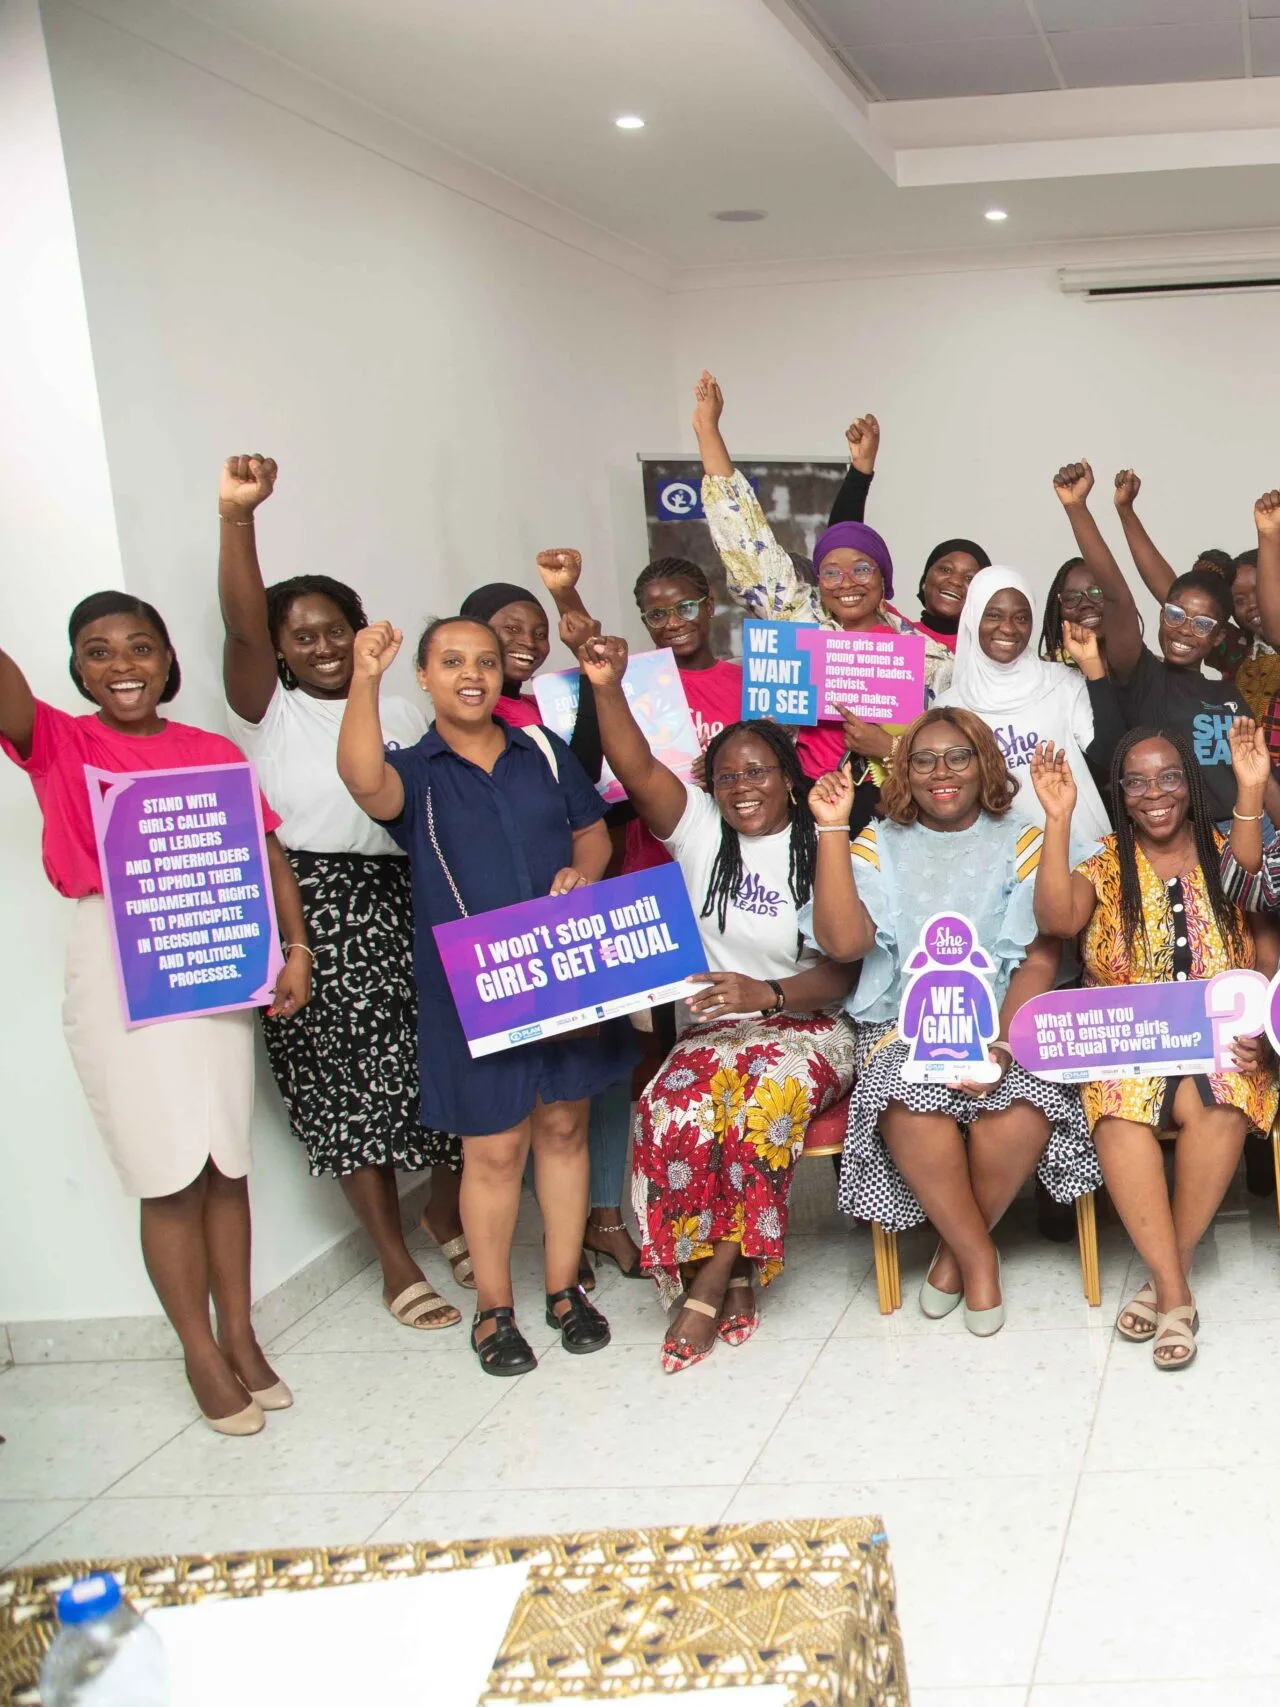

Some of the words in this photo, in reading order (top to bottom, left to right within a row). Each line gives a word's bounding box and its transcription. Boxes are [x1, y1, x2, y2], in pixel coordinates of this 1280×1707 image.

[749, 628, 778, 653] WE
[826, 639, 851, 649] more
[853, 639, 874, 651] girls
[876, 641, 894, 652] and
[749, 658, 801, 684] WANT
[826, 652, 854, 665] young
[857, 653, 890, 665] women
[893, 655, 904, 665] as
[825, 665, 874, 678] movement
[877, 667, 914, 681] leaders,
[825, 678, 867, 691] activists,
[748, 687, 770, 712] TO
[776, 689, 808, 715] SEE
[825, 692, 858, 703] change
[861, 692, 898, 706] makers,
[1192, 714, 1233, 740] SH
[993, 725, 1047, 758] She
[143, 796, 183, 814] STAND
[186, 793, 217, 809] WITH
[139, 817, 174, 834] GIRLS
[178, 812, 227, 830] CALLING
[149, 838, 167, 853] ON
[170, 832, 222, 850] LEADERS
[125, 858, 152, 876] AND
[155, 848, 249, 872] POWERHOLDERS
[139, 878, 155, 893] TO
[158, 872, 205, 891] UPHOLD
[208, 868, 242, 885] THEIR
[736, 873, 788, 904] She
[125, 893, 215, 915] FUNDAMENTAL
[218, 885, 260, 902] RIGHTS
[733, 898, 778, 917] LEADS
[149, 916, 166, 932] TO
[169, 906, 243, 929] PARTICIPATE
[475, 943, 486, 968] I
[558, 913, 606, 946] stop
[609, 895, 661, 930] until
[137, 938, 151, 954] IN
[154, 929, 209, 951] DECISION
[212, 923, 260, 942] MAKING
[930, 927, 967, 947] She
[159, 953, 184, 970] AND
[188, 944, 246, 966] POLITICAL
[475, 959, 548, 1002] GIRLS
[552, 945, 597, 981] GET
[601, 922, 679, 968] EQUAL
[937, 947, 963, 955] LEADS
[169, 966, 241, 988] PROCESSES.
[931, 987, 964, 1014] WE
[923, 1016, 973, 1043] GAIN
[1034, 1013, 1072, 1029] What
[1076, 1010, 1103, 1025] will
[1107, 1007, 1134, 1022] YOU
[1037, 1028, 1056, 1043] do
[1059, 1028, 1074, 1042] to
[1079, 1024, 1131, 1039] ensure
[1135, 1020, 1168, 1037] girls
[1039, 1043, 1063, 1060] get
[1068, 1038, 1107, 1056] Equal
[1111, 1036, 1156, 1052] Power
[1161, 1032, 1201, 1048] Now?
